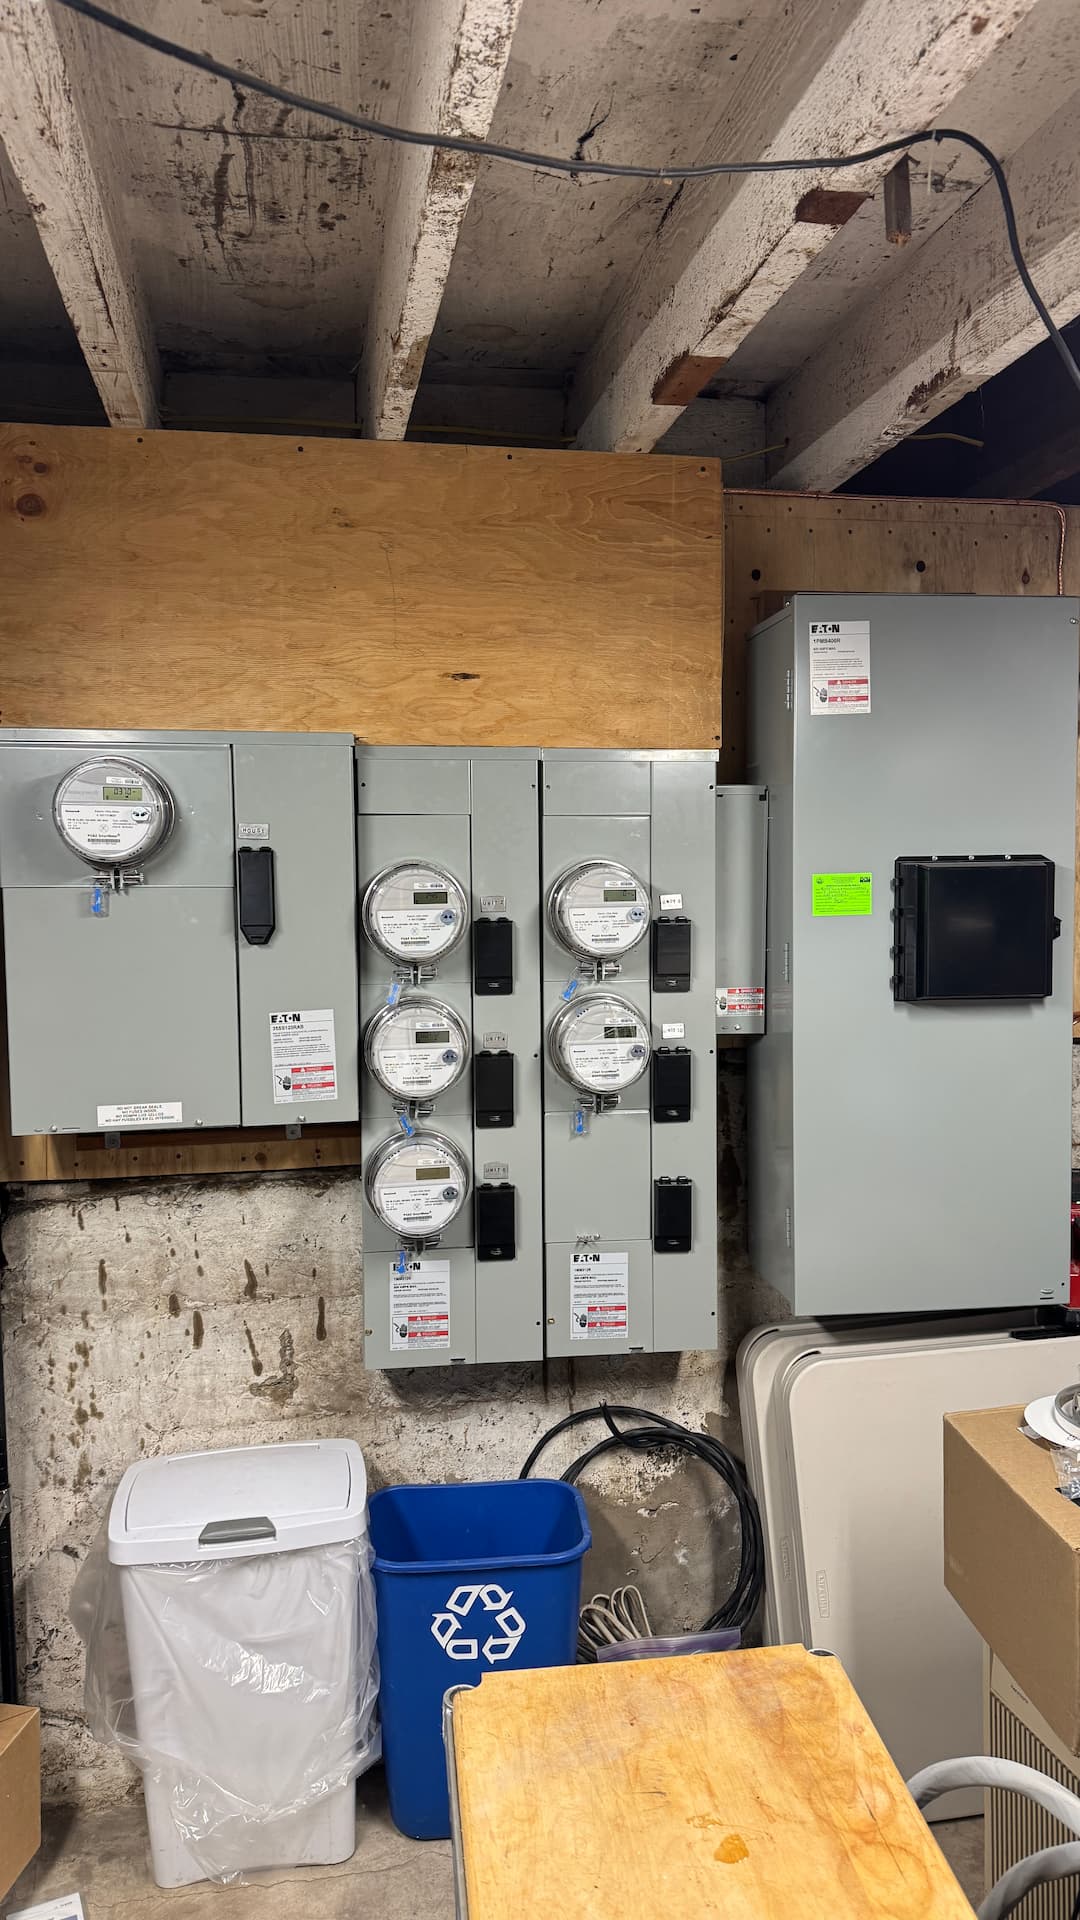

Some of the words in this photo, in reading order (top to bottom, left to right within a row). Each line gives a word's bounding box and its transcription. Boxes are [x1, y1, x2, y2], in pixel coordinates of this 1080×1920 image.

[811, 624, 840, 634] EATON
[271, 1013, 301, 1023] EATON
[573, 1253, 600, 1263] EATON
